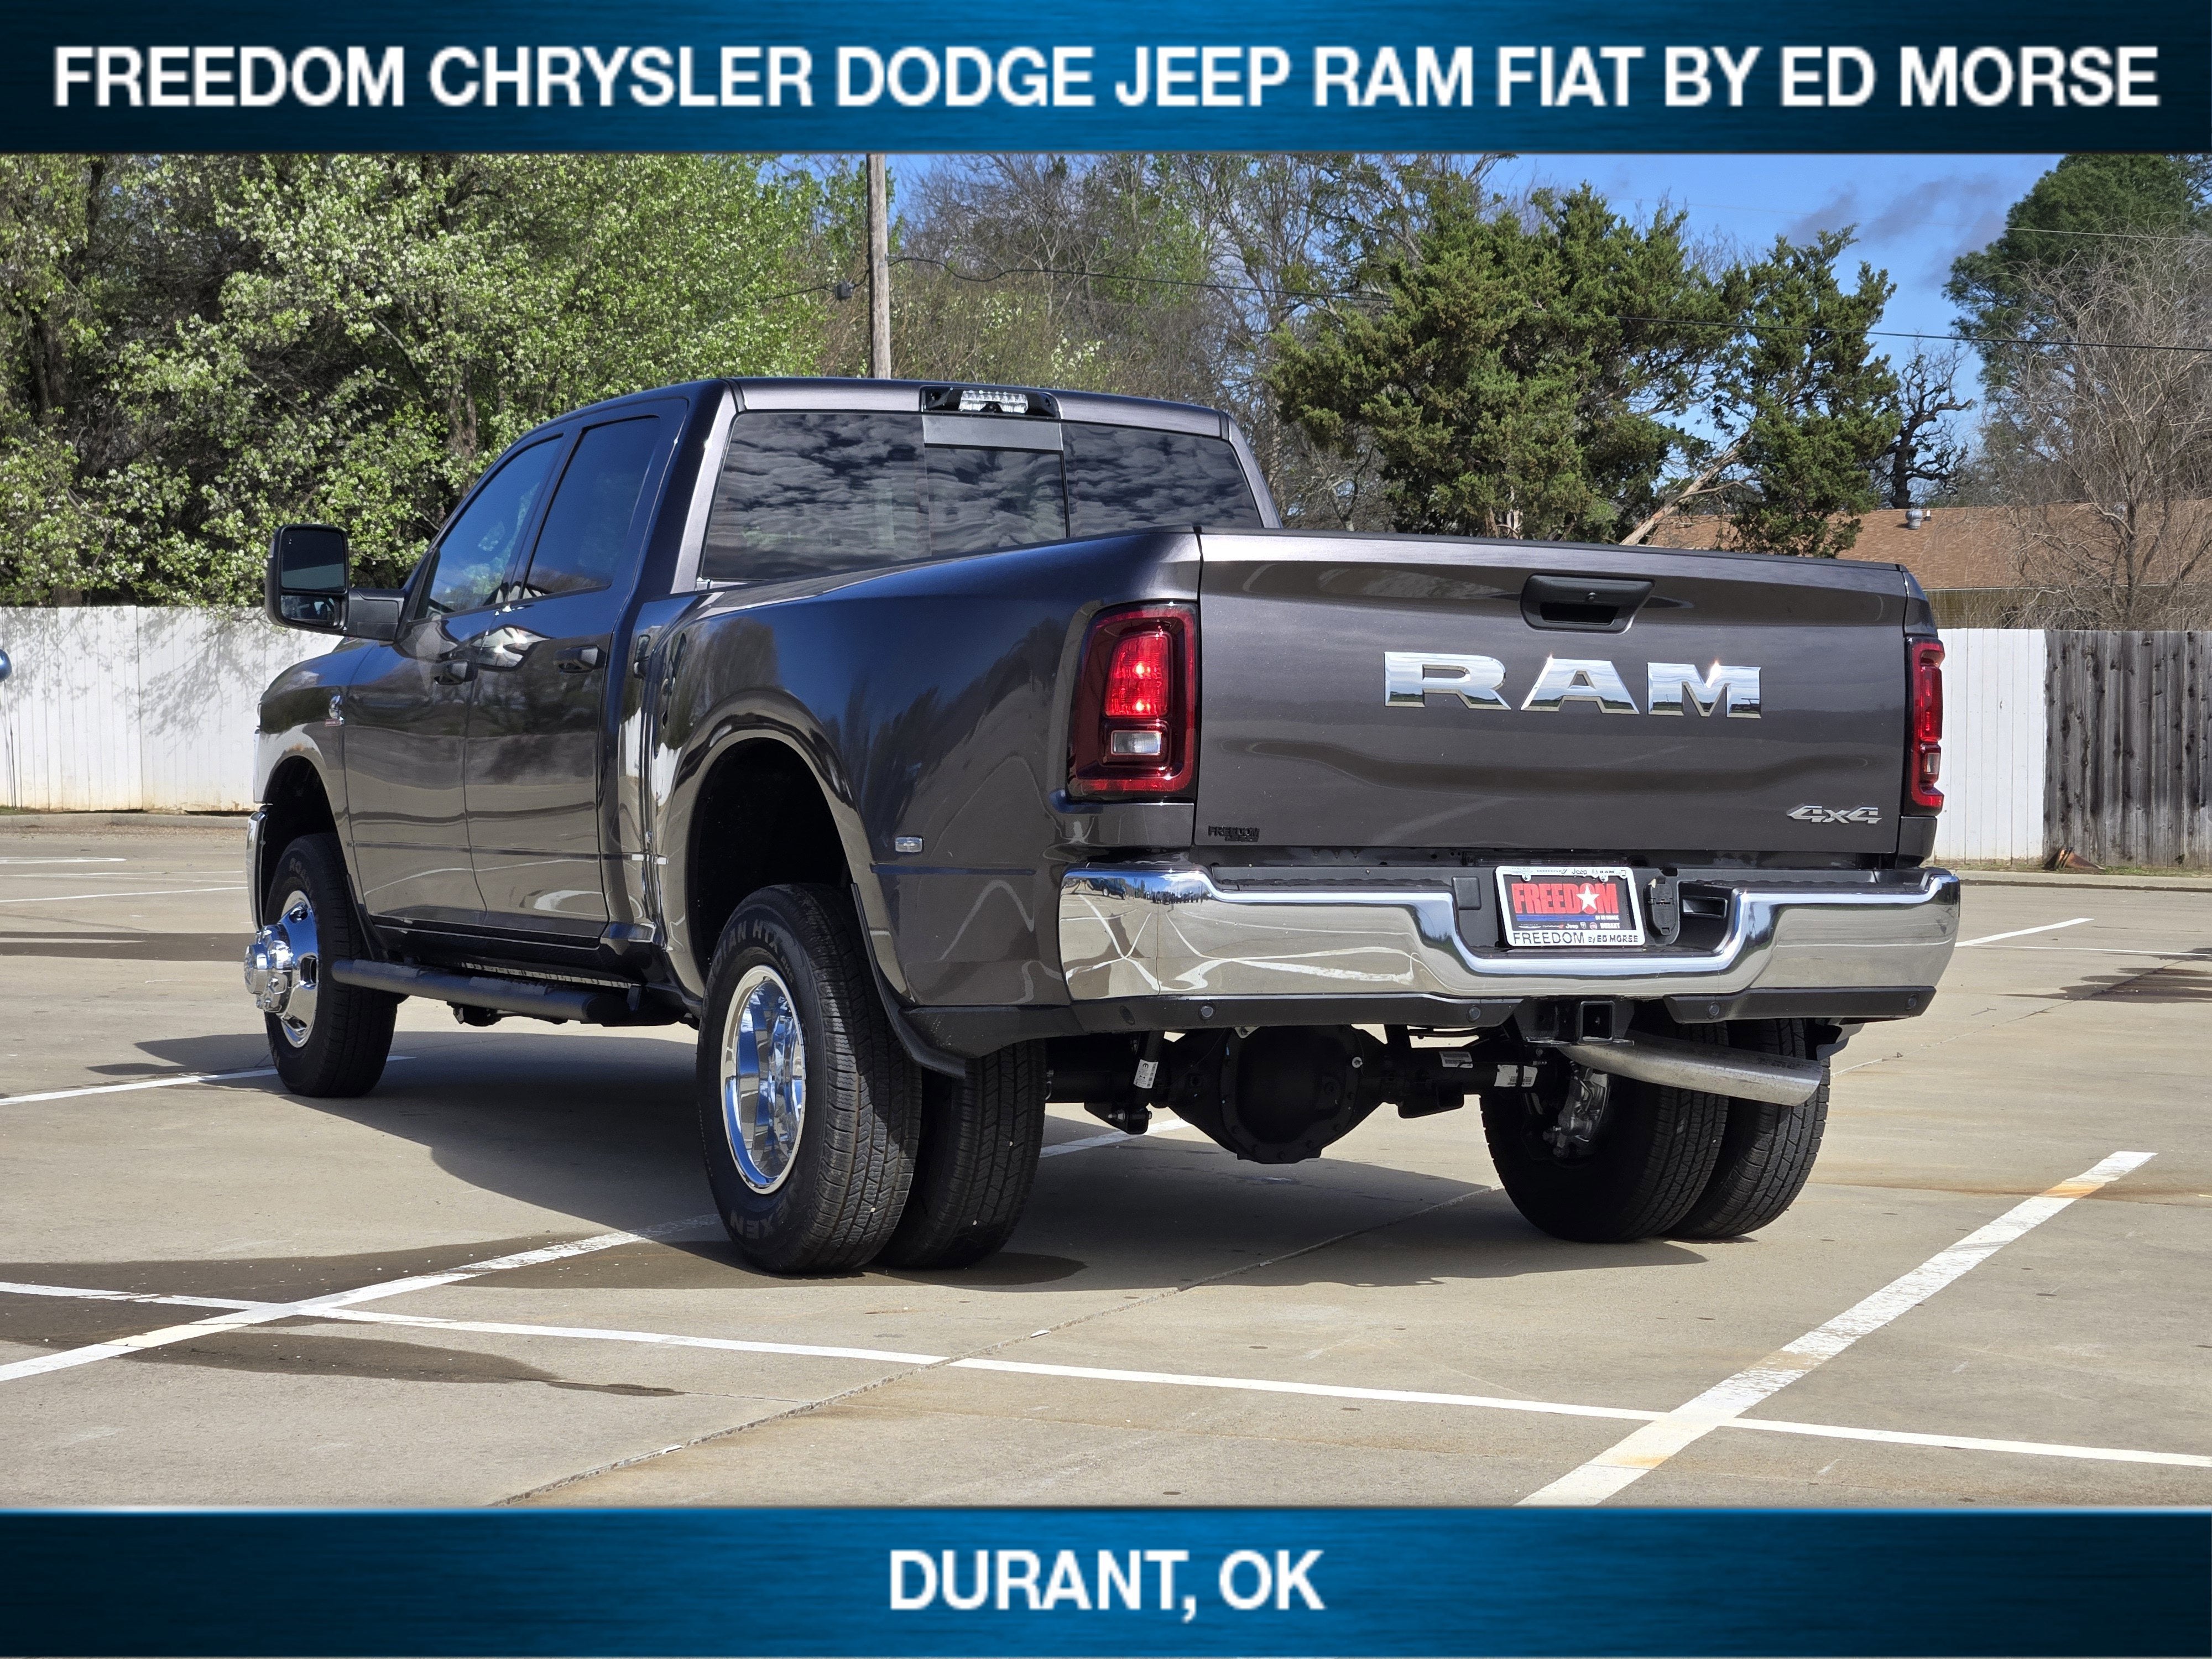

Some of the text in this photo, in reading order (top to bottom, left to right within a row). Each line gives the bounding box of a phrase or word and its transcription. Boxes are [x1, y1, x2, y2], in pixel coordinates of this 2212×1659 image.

[1384, 651, 1762, 719] RAM
[1513, 932, 1585, 945] FREEDOM
[1609, 935, 1639, 943] MORSE
